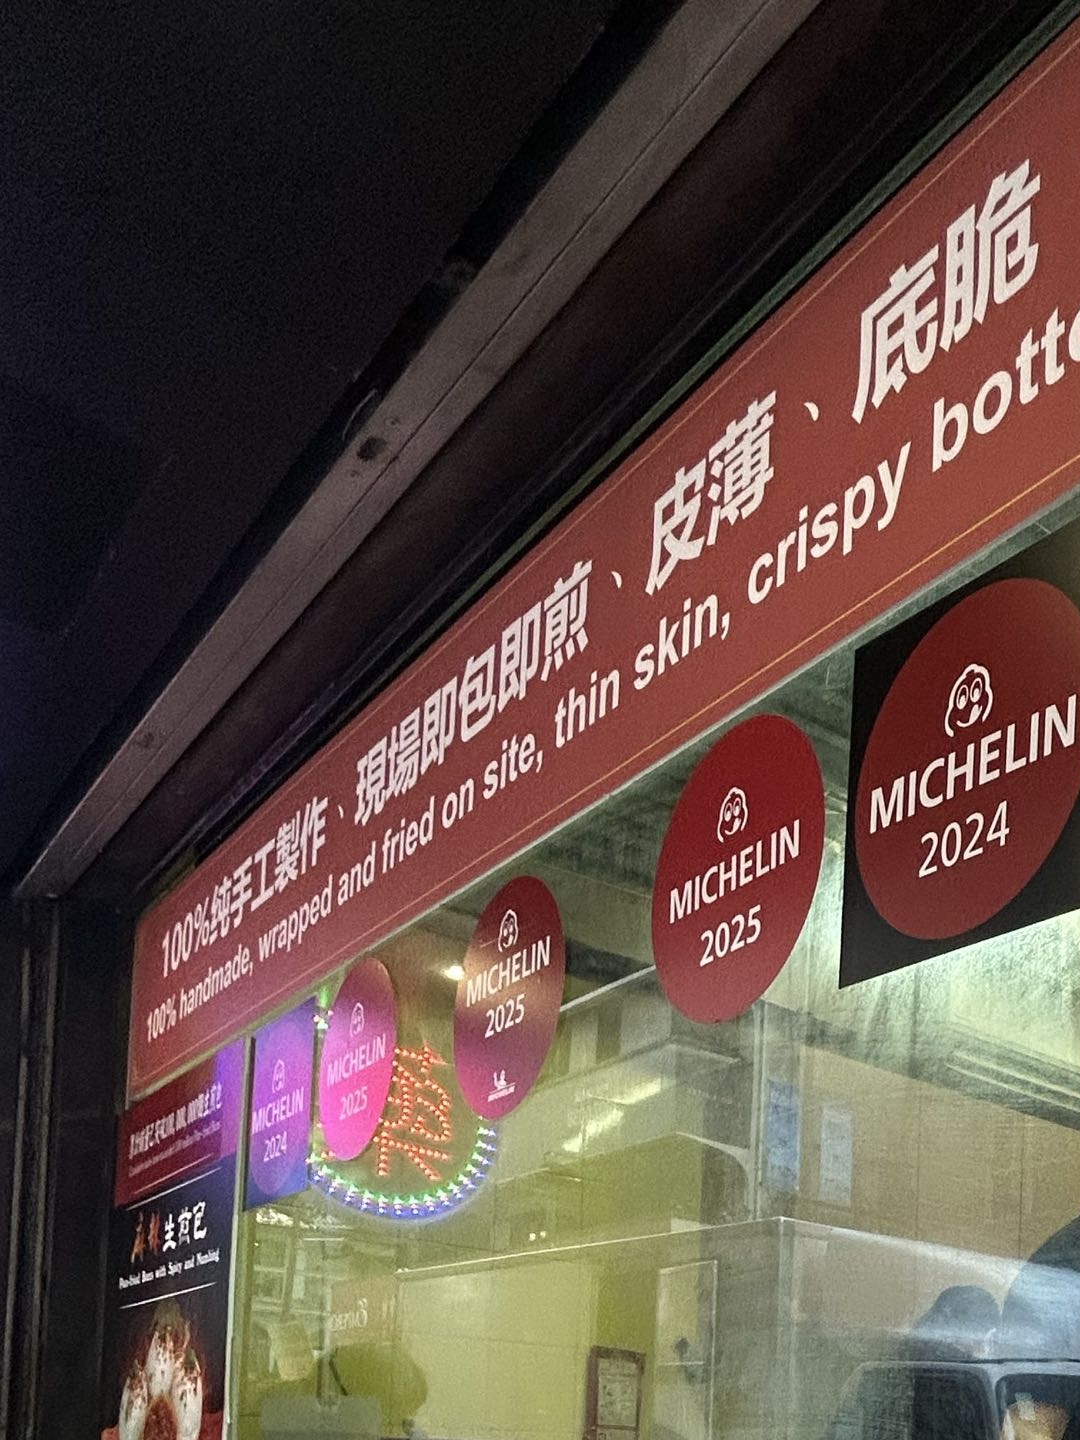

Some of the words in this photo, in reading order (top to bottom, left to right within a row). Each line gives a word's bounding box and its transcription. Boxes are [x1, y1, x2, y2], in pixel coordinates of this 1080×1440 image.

[147, 994, 177, 1042] 100%
[180, 944, 253, 1020] handmade,
[258, 874, 332, 962] wrapped
[337, 841, 375, 906] and
[382, 796, 435, 874] fried
[442, 778, 474, 828] on
[483, 733, 543, 800] site,
[554, 667, 620, 748] thin
[634, 594, 731, 689] skin,
[748, 442, 911, 605] crispy
[869, 694, 1077, 835] MICHELIN
[918, 801, 1010, 879] 2024
[669, 819, 801, 924] MICHELIN
[699, 905, 762, 967] 2025
[465, 934, 551, 1008] MICHELIN
[484, 994, 525, 1039] 2025
[327, 1033, 386, 1088] MICHELIN
[252, 1086, 304, 1135] MICHELIN
[339, 1086, 368, 1120] 2025
[263, 1131, 288, 1162] 2024
